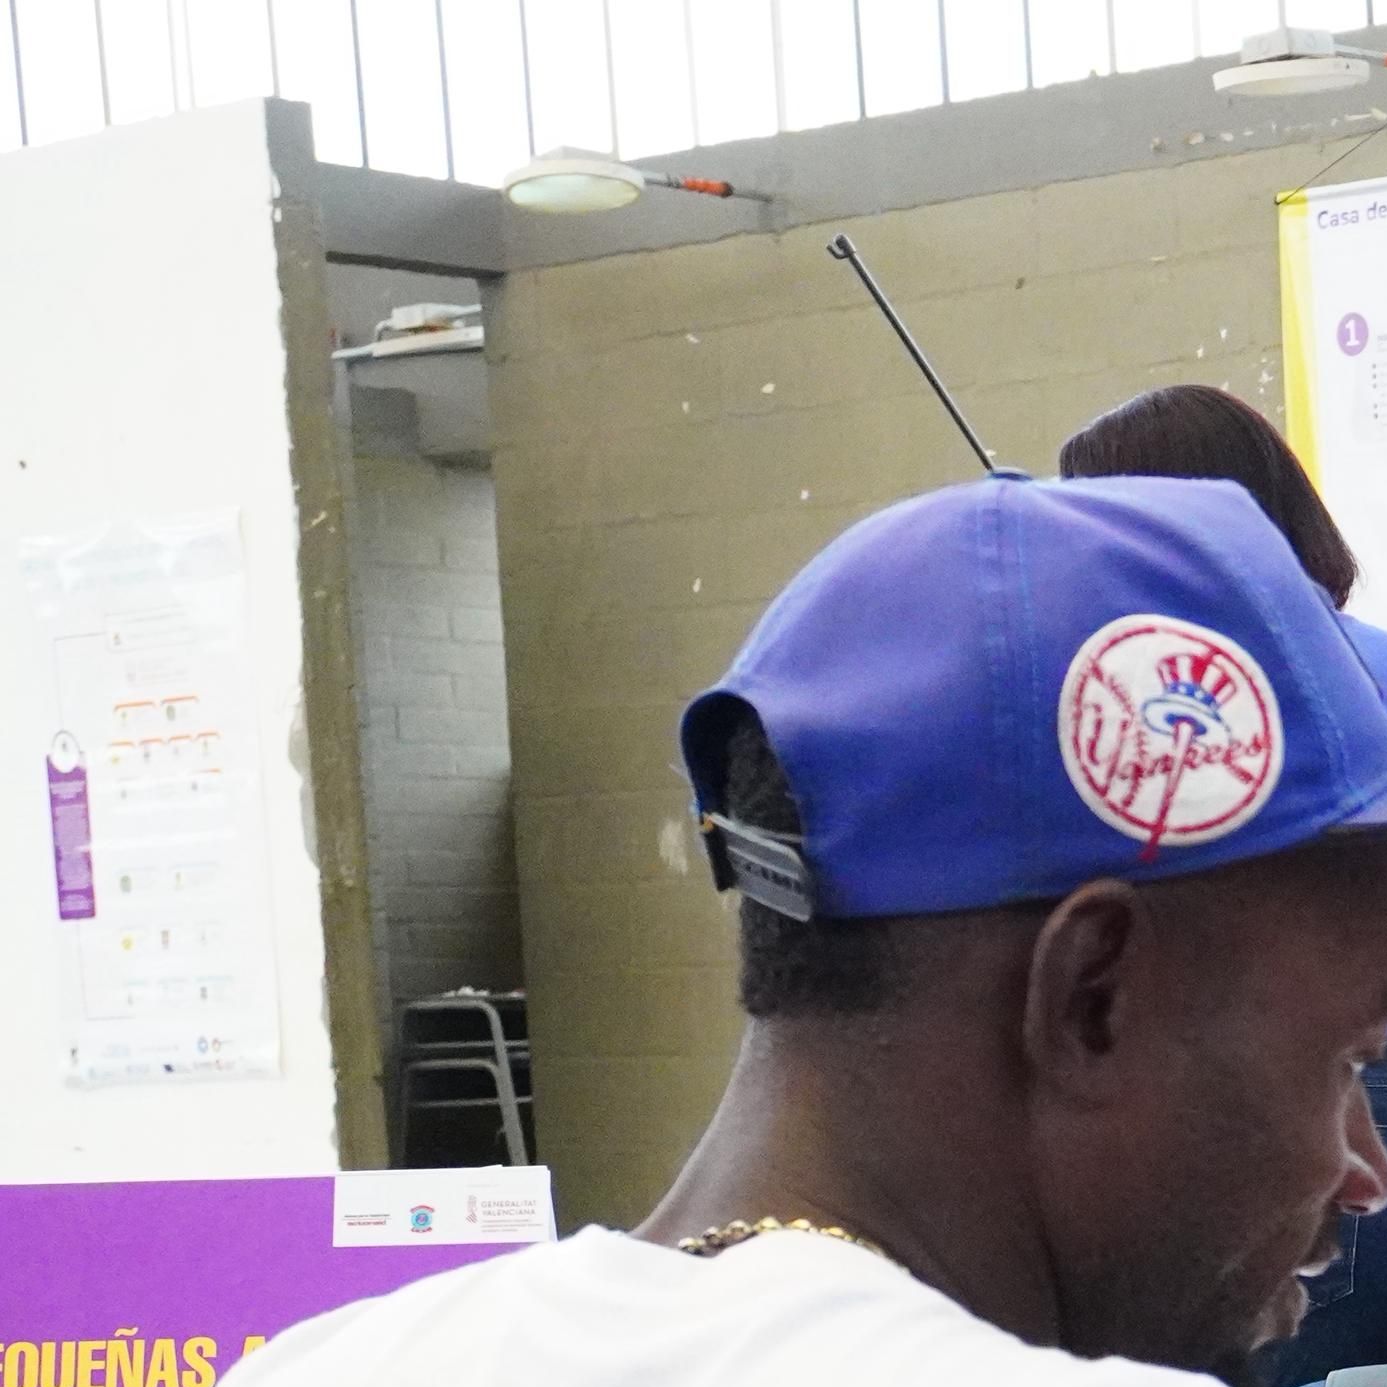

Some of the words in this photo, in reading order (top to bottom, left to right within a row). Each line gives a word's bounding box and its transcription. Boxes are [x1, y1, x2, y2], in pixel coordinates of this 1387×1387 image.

[1317, 208, 1360, 231] Casa
[1366, 200, 1387, 222] de
[1345, 320, 1359, 346] 1
